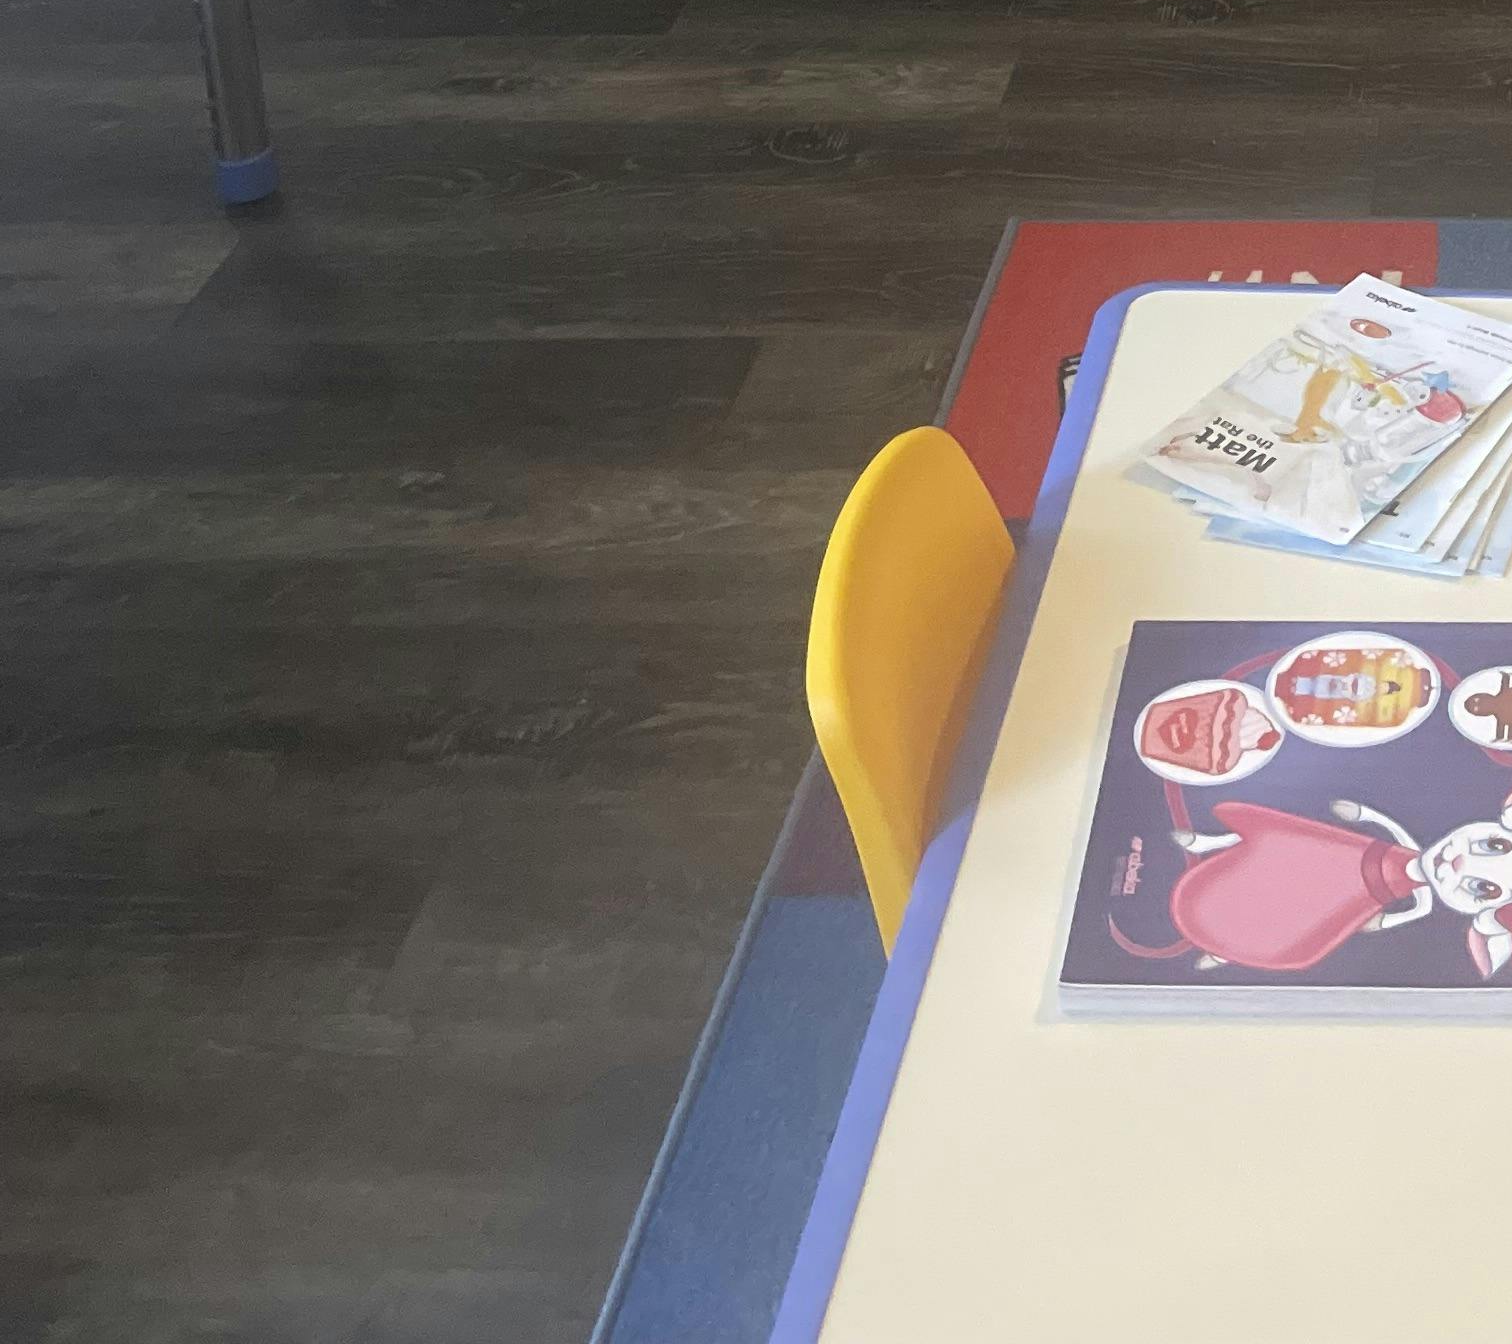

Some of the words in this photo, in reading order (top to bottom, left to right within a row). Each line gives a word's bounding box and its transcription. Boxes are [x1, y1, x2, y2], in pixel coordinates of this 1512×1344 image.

[1212, 417, 1244, 436] Rat
[1195, 427, 1277, 473] Matt
[1246, 433, 1274, 450] the
